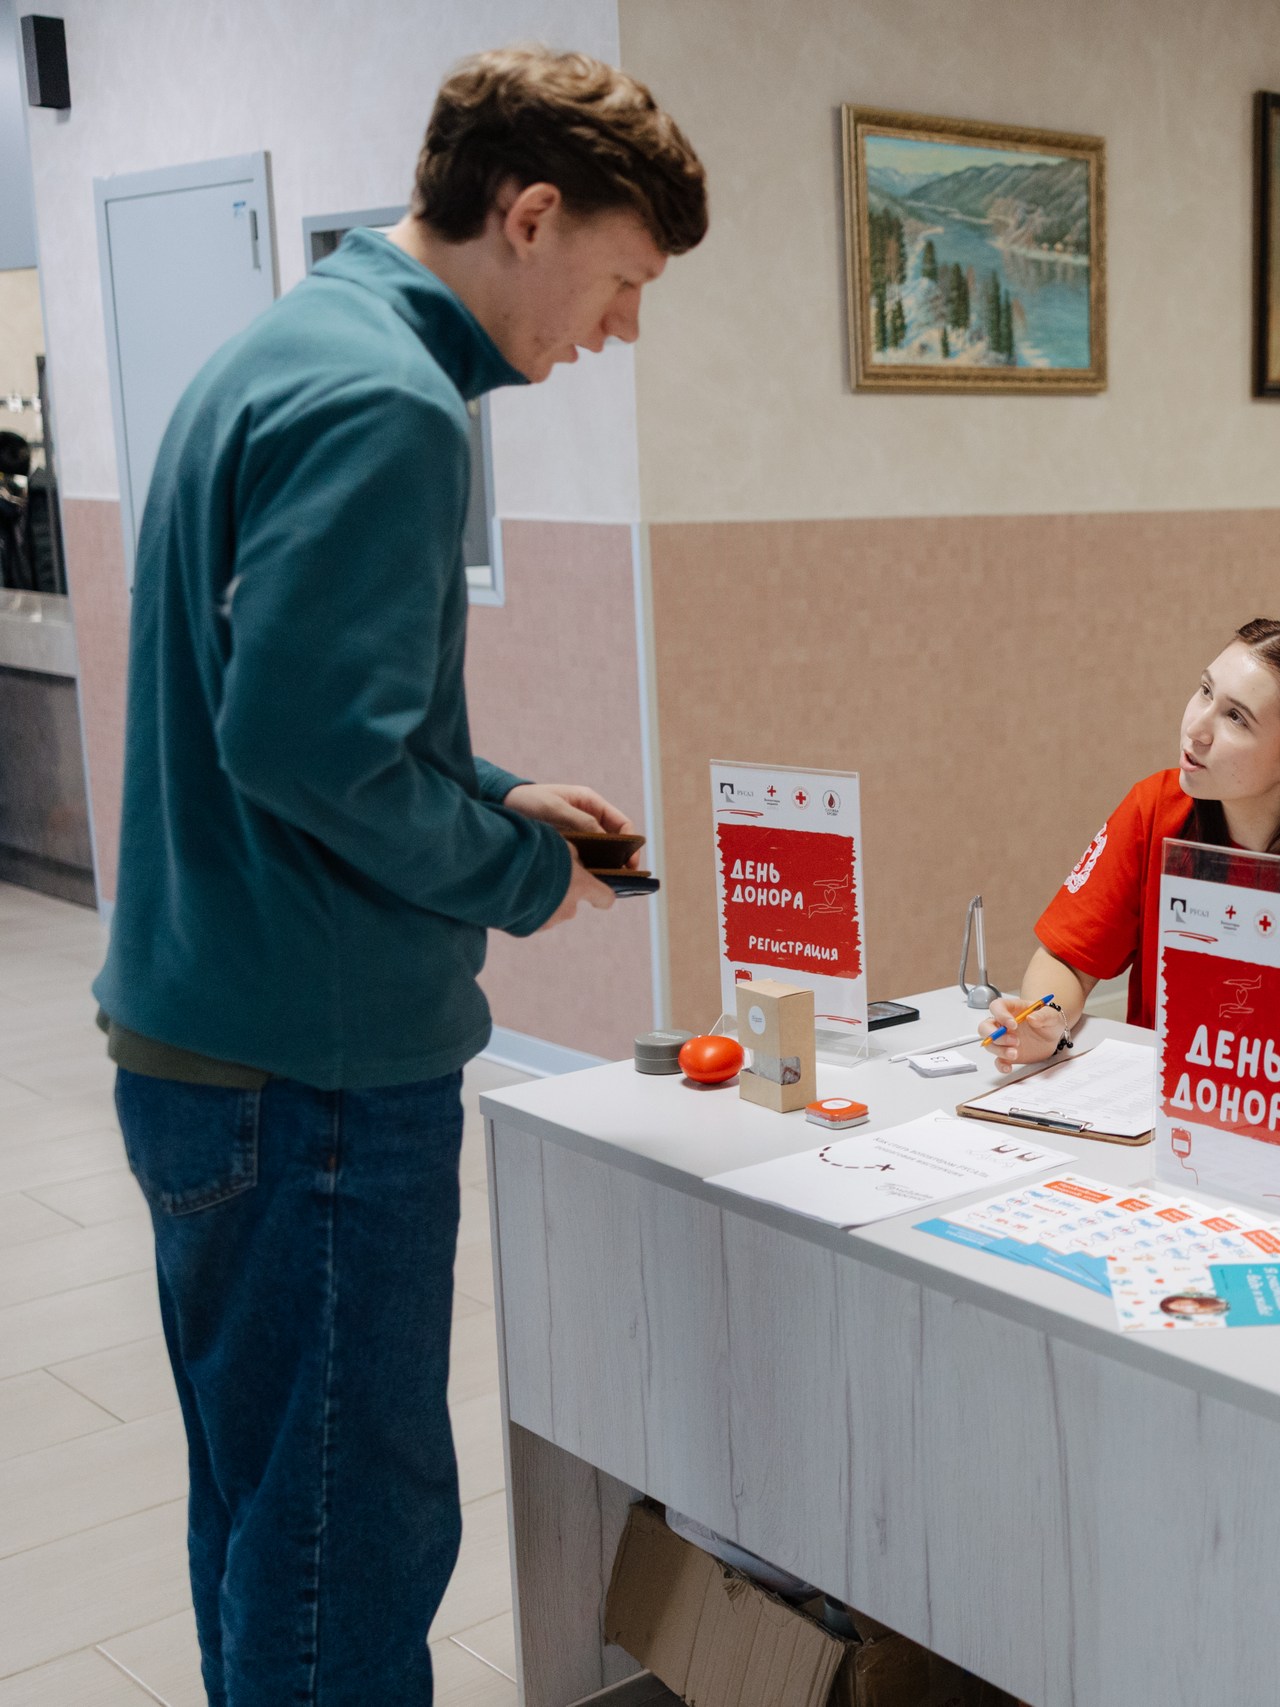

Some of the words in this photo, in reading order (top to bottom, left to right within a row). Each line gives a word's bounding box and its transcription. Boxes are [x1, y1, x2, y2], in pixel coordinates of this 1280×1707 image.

[730, 859, 780, 884] ДЕНЬ
[731, 884, 804, 910] ДОНОРА
[748, 935, 839, 961] РЕГИСТРАЦИЯ
